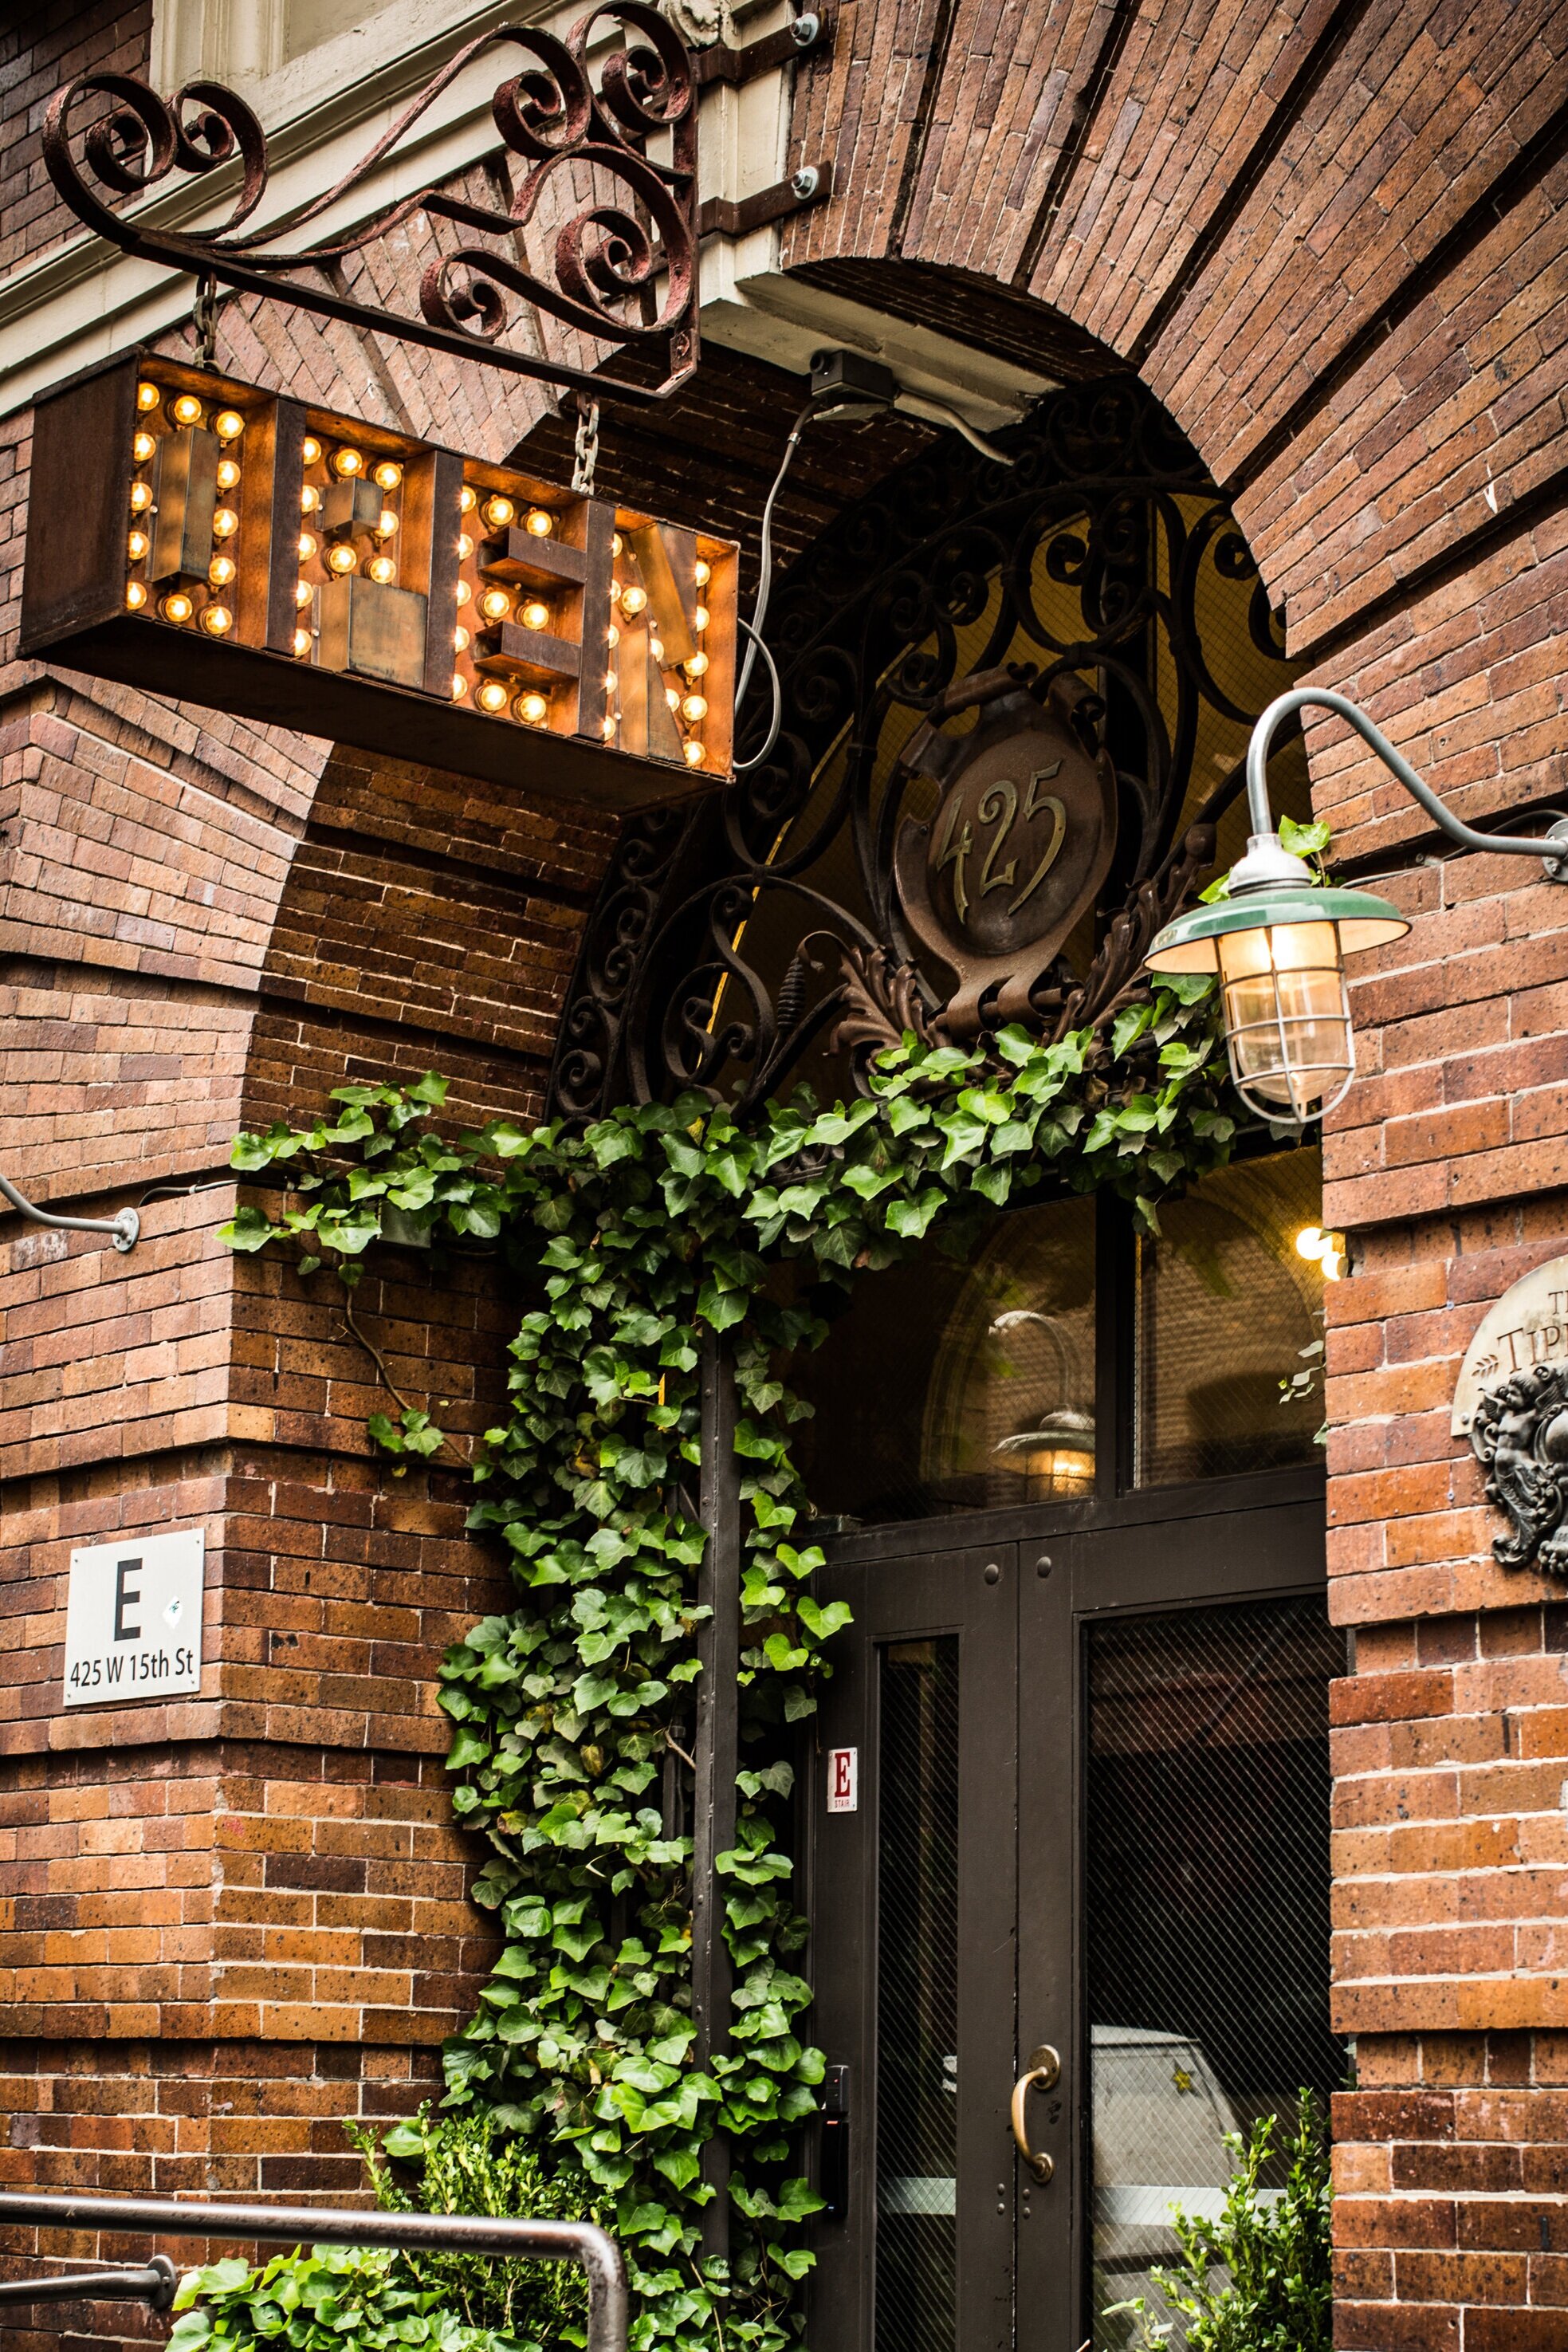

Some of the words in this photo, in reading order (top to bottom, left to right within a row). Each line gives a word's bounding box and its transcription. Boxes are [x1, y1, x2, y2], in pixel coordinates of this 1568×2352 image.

[126, 355, 740, 784] OPEN
[936, 759, 1067, 925] 425
[114, 1557, 143, 1642] E
[69, 1659, 102, 1688] 425
[106, 1655, 124, 1684] W
[129, 1649, 170, 1681] 15th
[175, 1647, 194, 1676] St
[834, 1752, 851, 1798] E
[834, 1799, 850, 1809] STAIR
